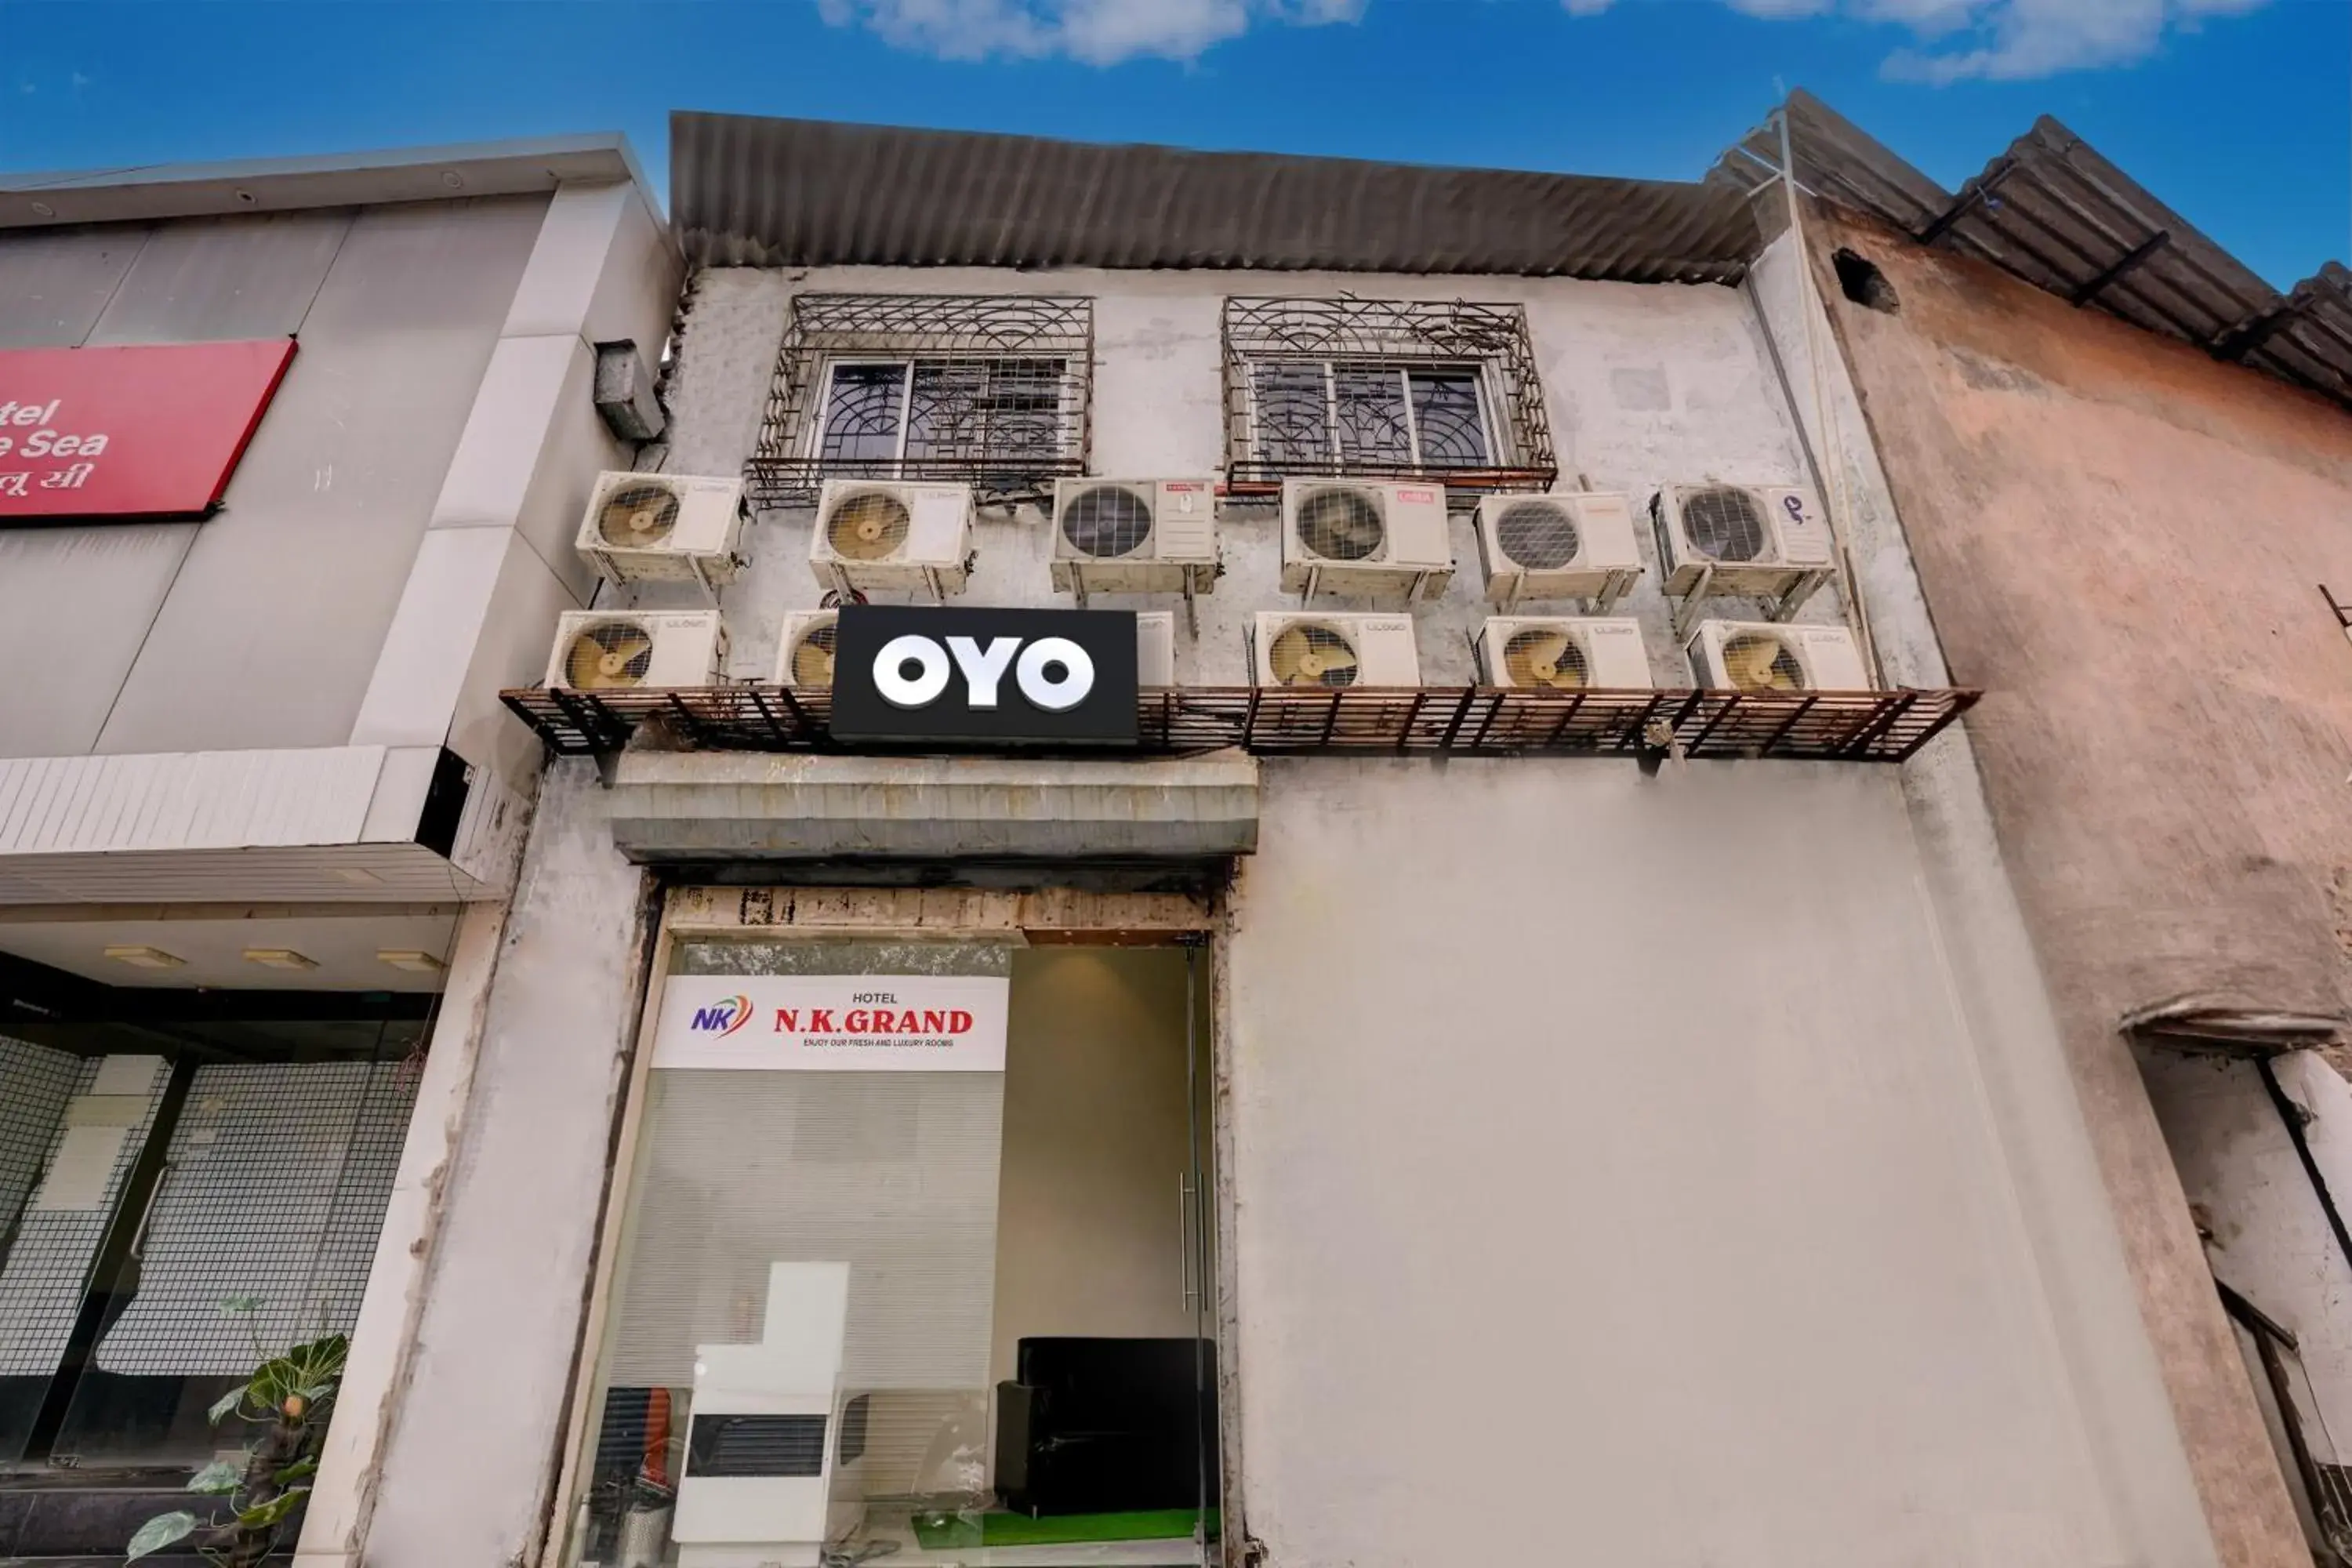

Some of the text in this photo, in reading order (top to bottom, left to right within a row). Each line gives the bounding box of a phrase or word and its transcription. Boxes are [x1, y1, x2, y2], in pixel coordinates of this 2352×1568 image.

[0, 399, 62, 426] tel
[20, 430, 109, 458] Sea
[873, 634, 1095, 713] OYO
[853, 993, 898, 1004] HOTEL
[691, 1007, 736, 1031] NK
[774, 1009, 973, 1034] N.K.GRAND
